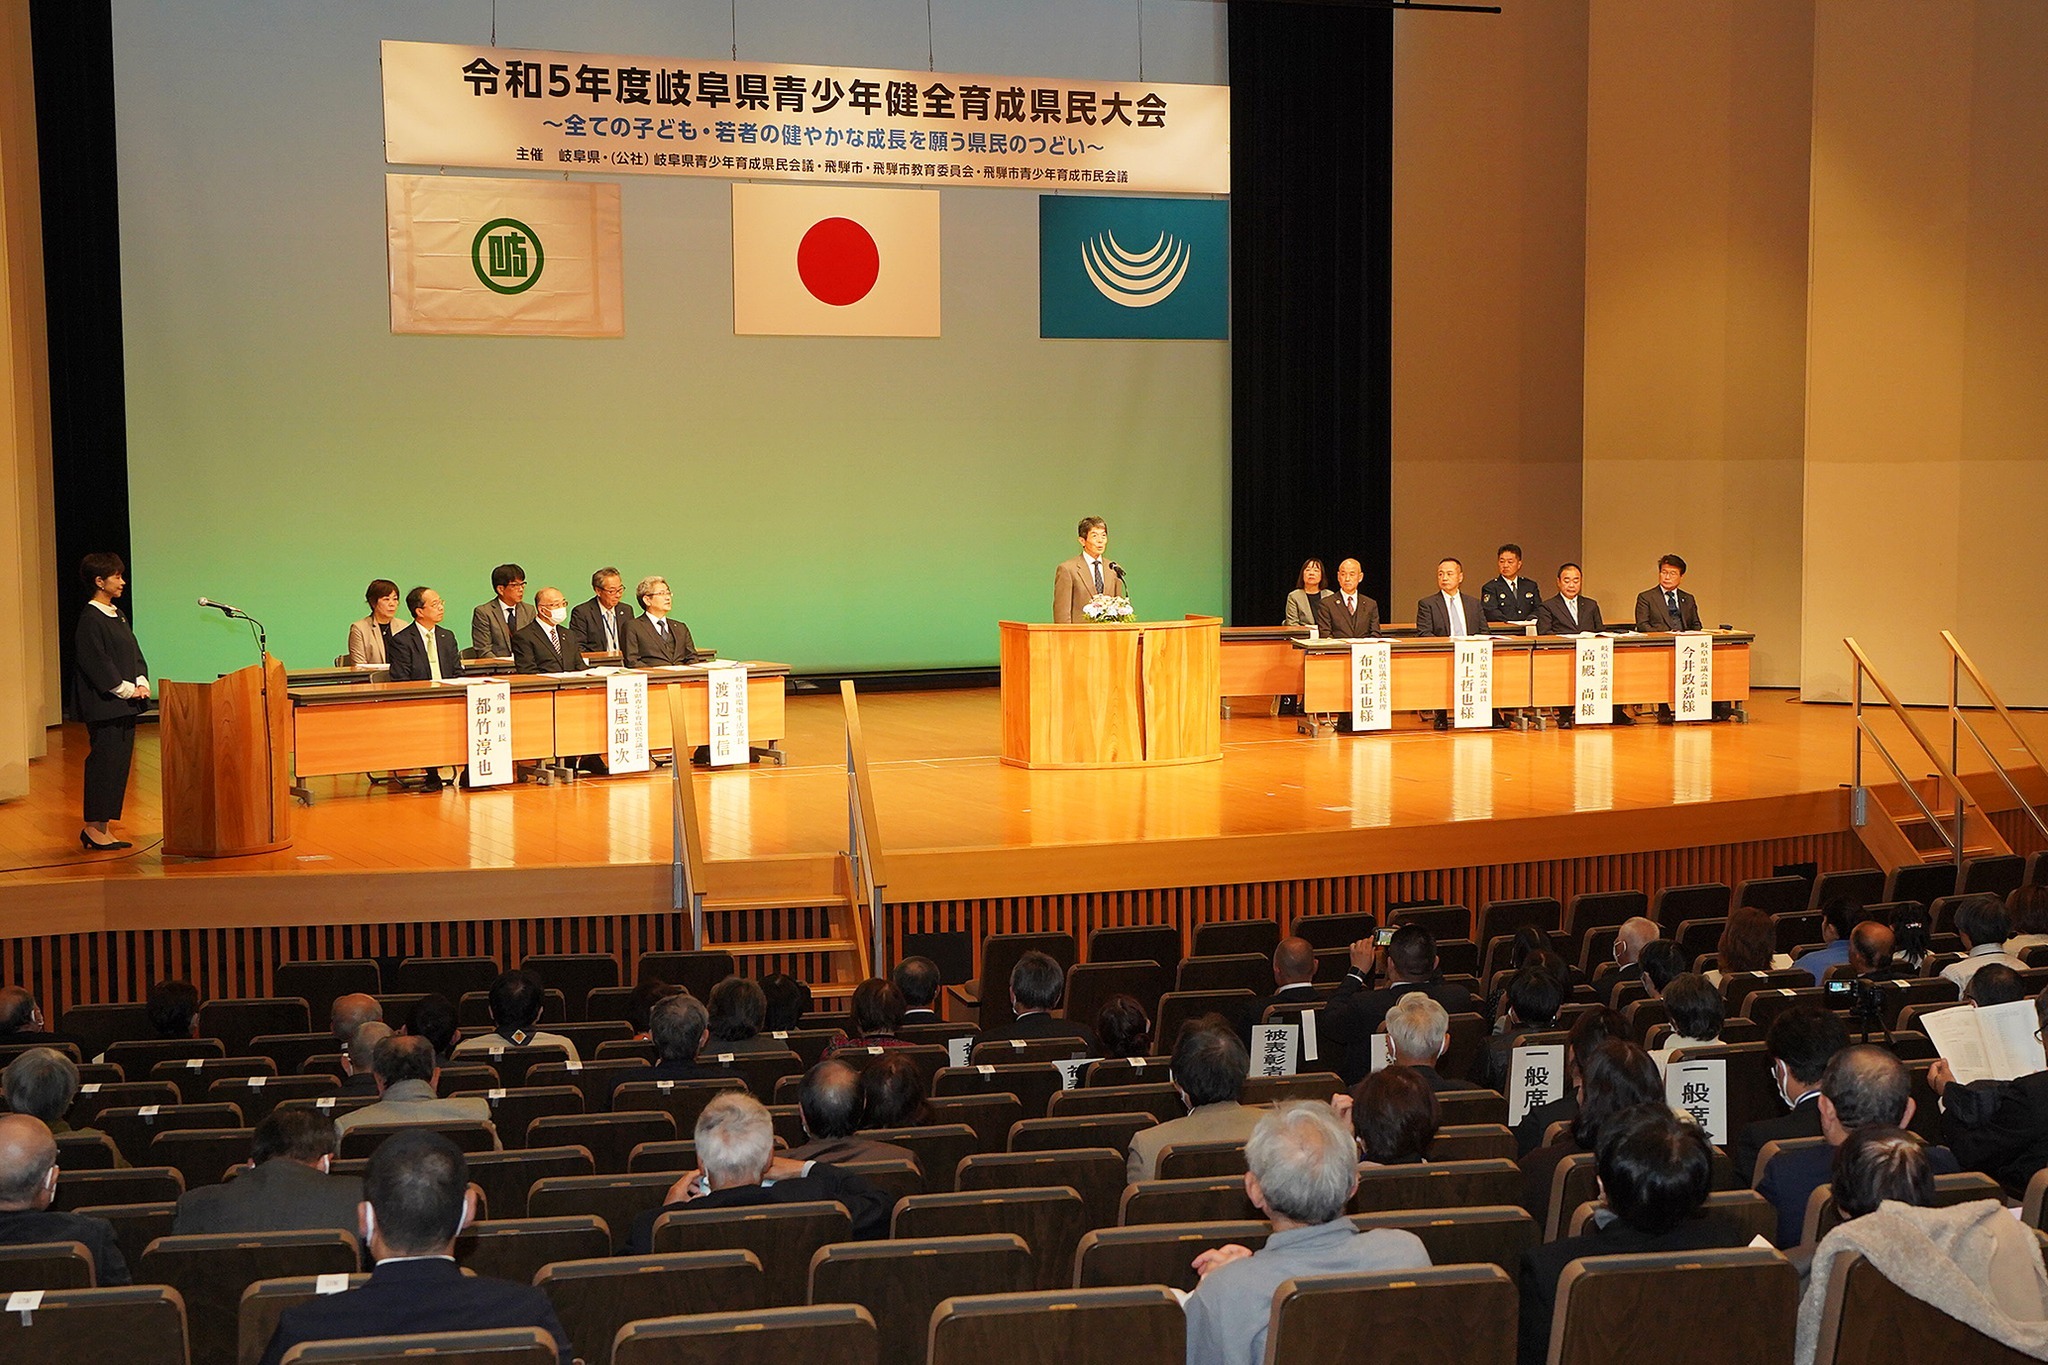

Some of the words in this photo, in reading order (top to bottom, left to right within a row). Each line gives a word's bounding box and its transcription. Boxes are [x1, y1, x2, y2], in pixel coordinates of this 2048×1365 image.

[462, 57, 1168, 129] 令和5年度岐阜県青少年健全育成県民大会
[516, 147, 544, 162] 主催
[1359, 654, 1374, 723] 布俣正也様
[1461, 652, 1475, 720] 川上哲也様
[1479, 647, 1488, 702] 岐阜県議会議員
[1600, 645, 1609, 699] 岐阜県議会議員
[1682, 646, 1696, 713] 今井政嘉様
[1700, 641, 1709, 696] 岐阜県議会議員
[475, 697, 493, 776] 都竹淳也
[613, 687, 630, 764] 塩屋節次
[715, 682, 731, 757] 渡辺正信
[1524, 1052, 1550, 1108] 一般席
